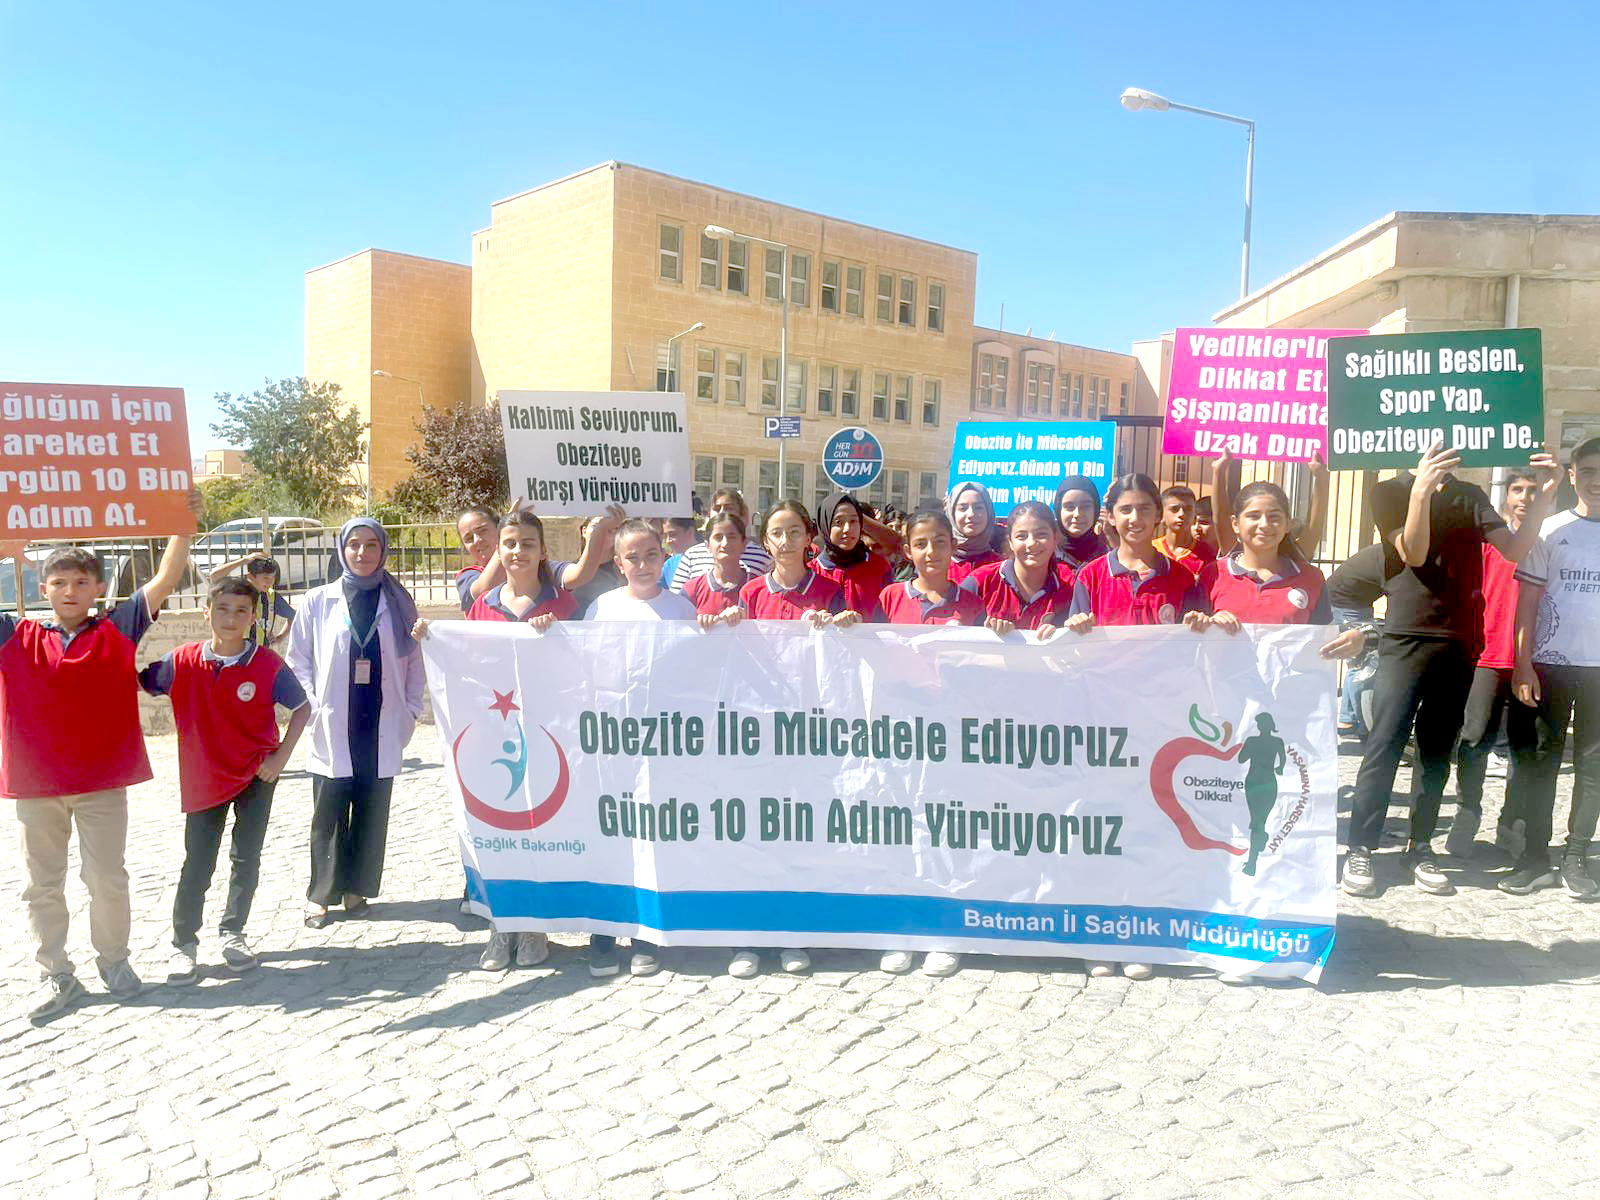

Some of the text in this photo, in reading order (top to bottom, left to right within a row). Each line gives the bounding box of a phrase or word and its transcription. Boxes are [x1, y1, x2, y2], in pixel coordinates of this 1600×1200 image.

[1189, 334, 1328, 359] Yediklerin
[1345, 346, 1524, 379] Sağlıklı Beslen,
[1199, 366, 1287, 391] Dikkat
[0, 392, 172, 426] ğlığın İçin
[1171, 397, 1328, 426] Şişmanlıkta
[1379, 386, 1490, 416] Spor Yap,
[507, 405, 683, 434] Kalbimi Seviyorum.
[766, 417, 780, 438] P
[0, 431, 160, 456] areket Et
[835, 442, 851, 450] HER
[965, 432, 1103, 451] Obezite İle Mücadele
[1194, 430, 1259, 455] Uzak
[1333, 423, 1539, 455] Obeziteye Dur De.
[556, 441, 642, 470] Obeziteye
[0, 464, 189, 495] rgün 10 Bin
[1064, 461, 1079, 476] 10
[1083, 461, 1105, 478] Bin
[527, 476, 677, 506] Karşı Yürüyorum
[1013, 485, 1057, 506] Yürüy
[7, 502, 146, 529] Adım At.
[1560, 568, 1600, 580] Emira
[1580, 583, 1600, 593] BETT
[579, 701, 1139, 769] Obezite İle Mücadele Ediyoruz.
[1183, 776, 1244, 791] Obeziteye
[1194, 789, 1233, 803] Dikkat
[598, 792, 1123, 857] Günde 10 Bin Adım Yürüyoruz
[1280, 795, 1308, 838] HAREKET
[473, 836, 518, 853] Sağlık
[521, 838, 586, 855] Bakanlığı
[1268, 834, 1284, 853] KAT
[964, 908, 1310, 957] Batman İl Sağlık Müdürlüğü
